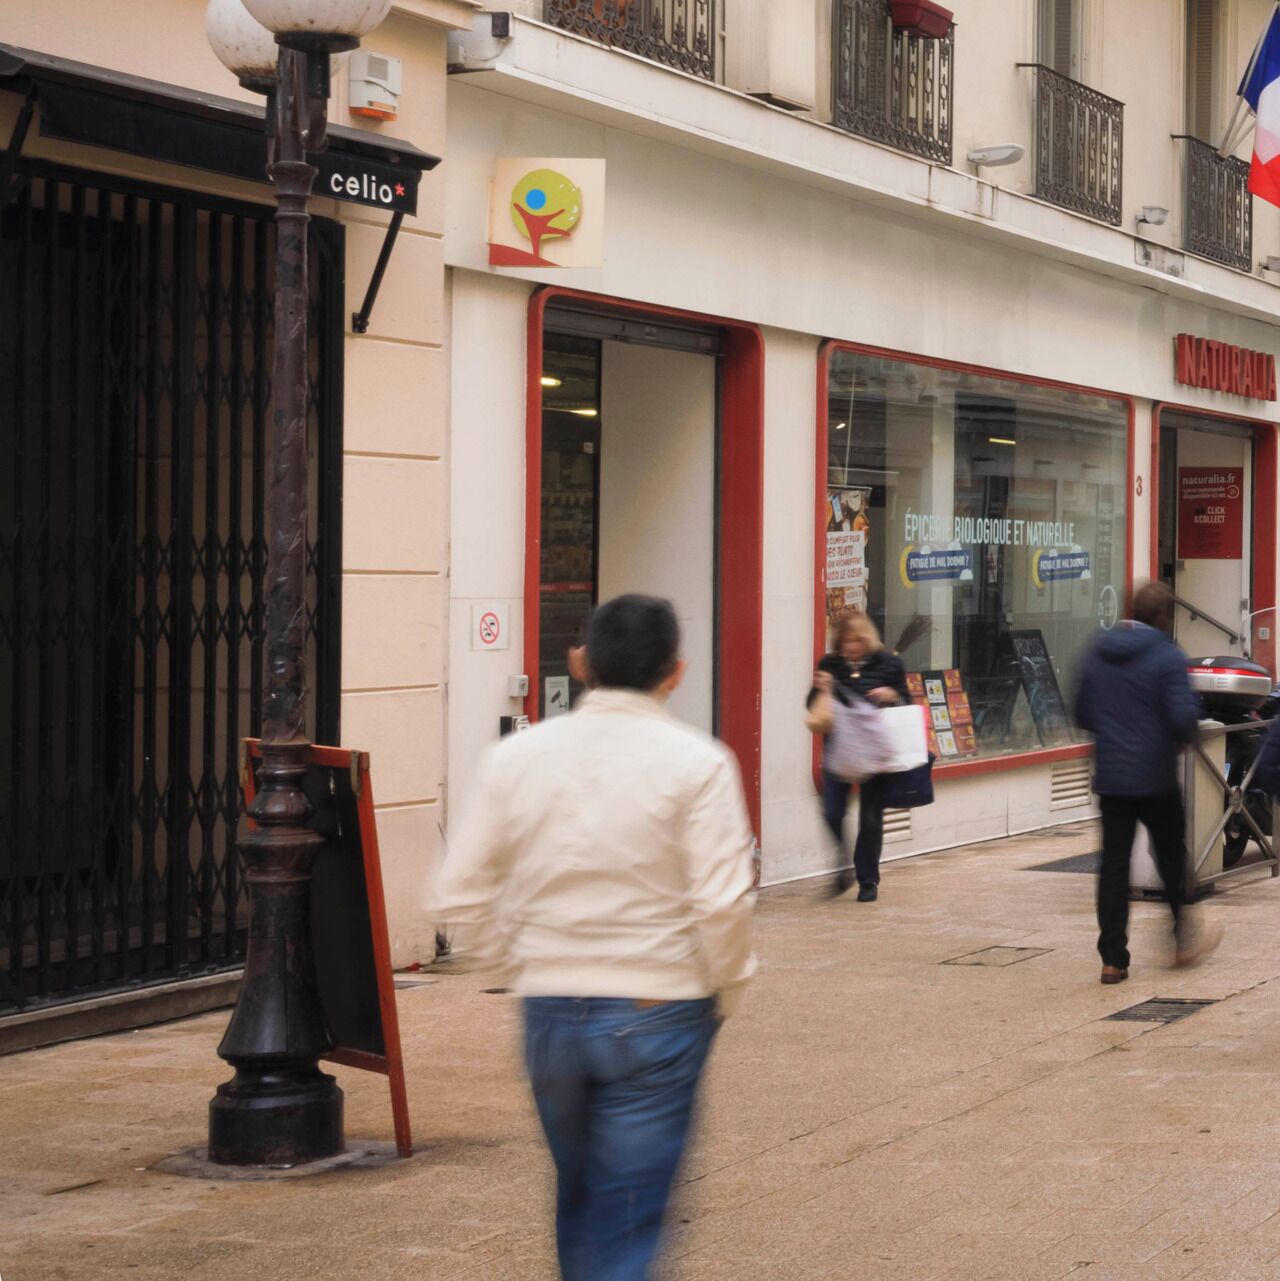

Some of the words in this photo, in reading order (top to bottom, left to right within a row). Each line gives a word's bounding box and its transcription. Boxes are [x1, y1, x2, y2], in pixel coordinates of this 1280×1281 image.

[1176, 333, 1278, 402] NATURALIA
[1135, 475, 1143, 496] 3
[1182, 473, 1236, 485] naturalia.fr
[1207, 506, 1225, 515] CLICK
[954, 516, 1012, 545] BIOLOGIQUE
[1014, 520, 1025, 545] ET
[1027, 521, 1075, 546] NATURELLE
